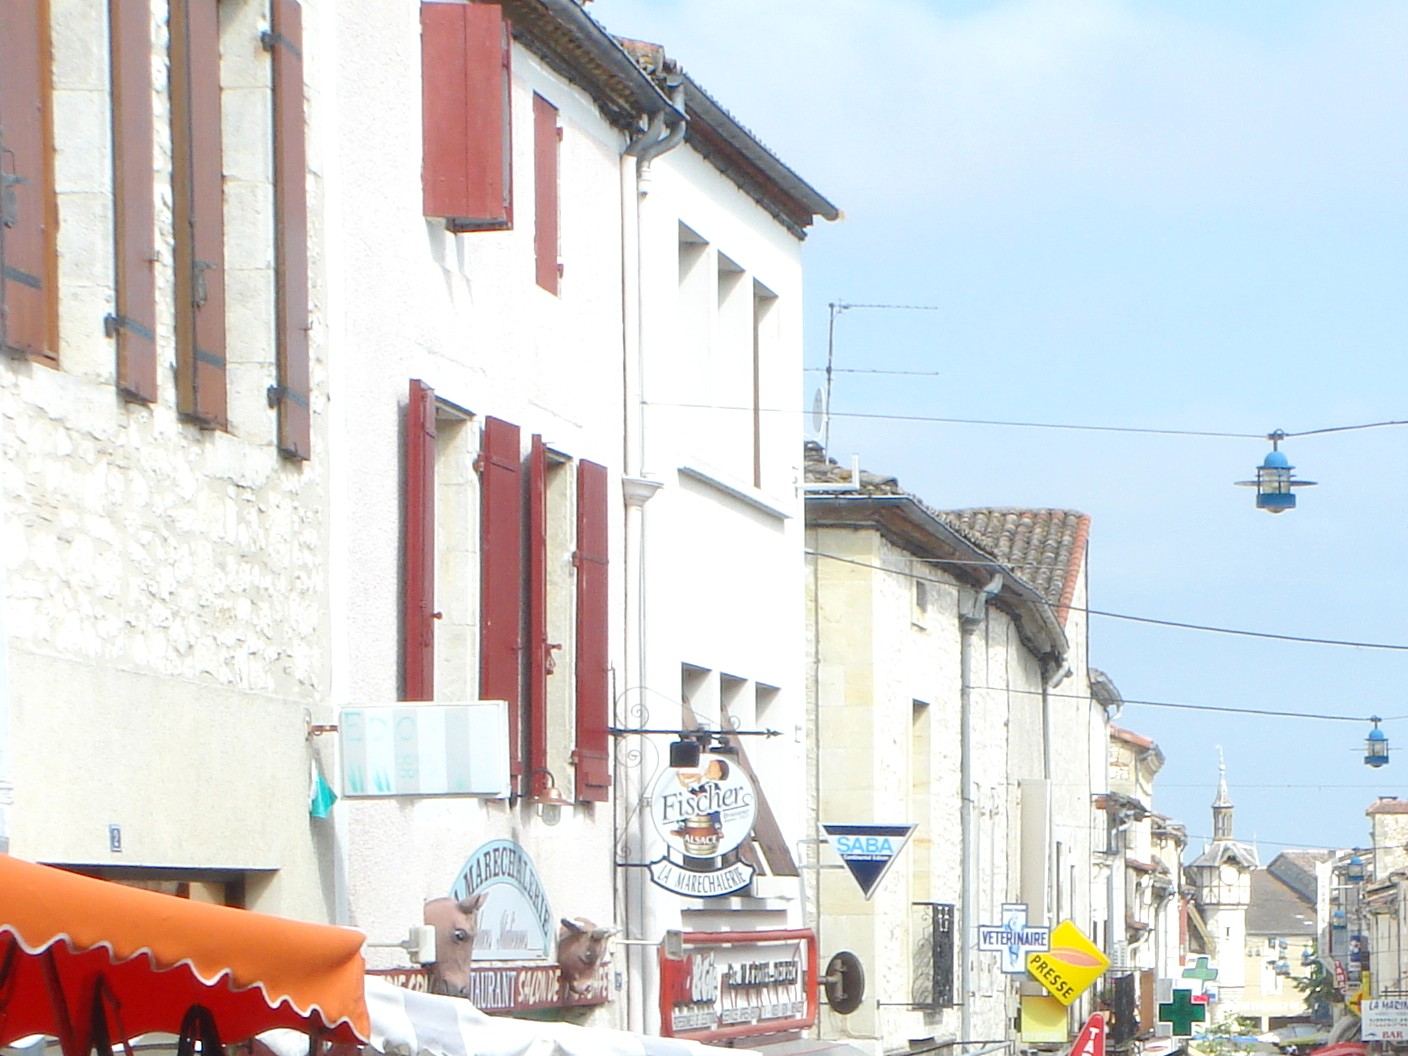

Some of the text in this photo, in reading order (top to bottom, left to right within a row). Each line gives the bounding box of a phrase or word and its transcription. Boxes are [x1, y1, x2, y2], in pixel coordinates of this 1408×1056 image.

[661, 784, 744, 821] Fischer
[836, 835, 894, 854] SABA
[675, 867, 747, 893] MARECHALERIE
[981, 930, 1048, 947] VETERINAIRE
[470, 970, 517, 1010] TAURANT
[1029, 954, 1075, 1000] PRESSE
[1382, 1031, 1404, 1039] BAR
